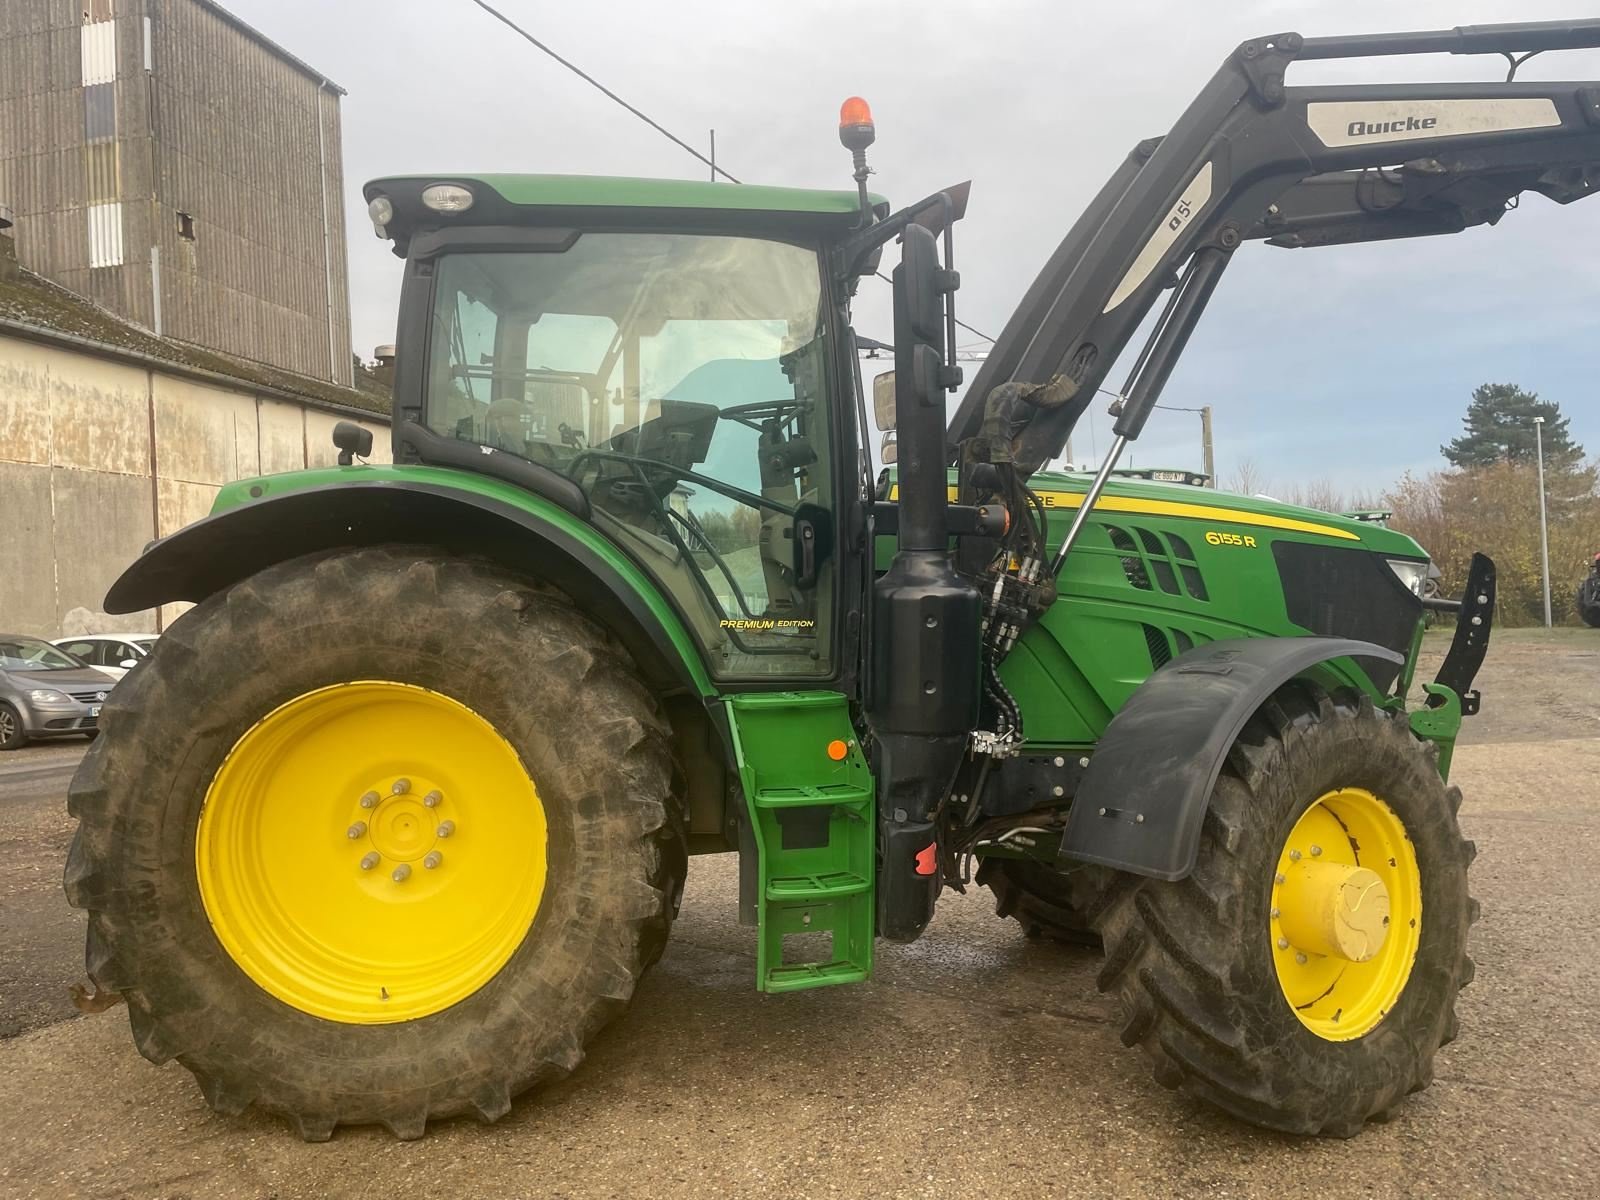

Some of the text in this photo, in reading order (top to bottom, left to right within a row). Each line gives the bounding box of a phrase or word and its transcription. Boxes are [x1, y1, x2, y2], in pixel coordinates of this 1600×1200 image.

[1347, 116, 1437, 137] Quicke
[719, 619, 815, 630] PREMIUM EDITION
